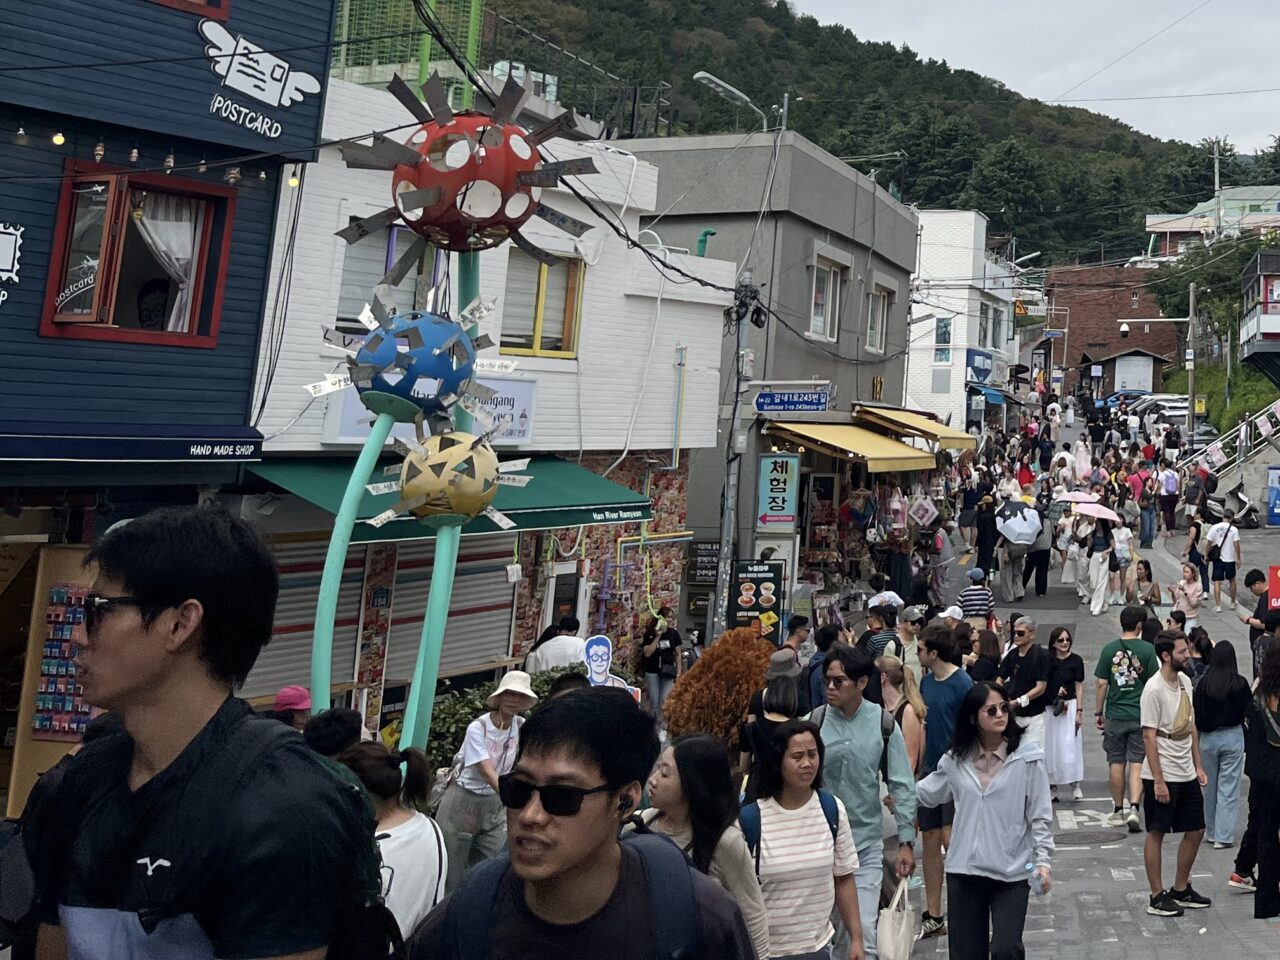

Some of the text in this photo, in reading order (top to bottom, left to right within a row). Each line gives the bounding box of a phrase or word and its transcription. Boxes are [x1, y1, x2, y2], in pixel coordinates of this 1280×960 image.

[212, 95, 282, 138] POSTCARD
[56, 274, 94, 307] postcard
[190, 444, 255, 456] HAND MADE SHOP
[767, 459, 789, 512] 체험장
